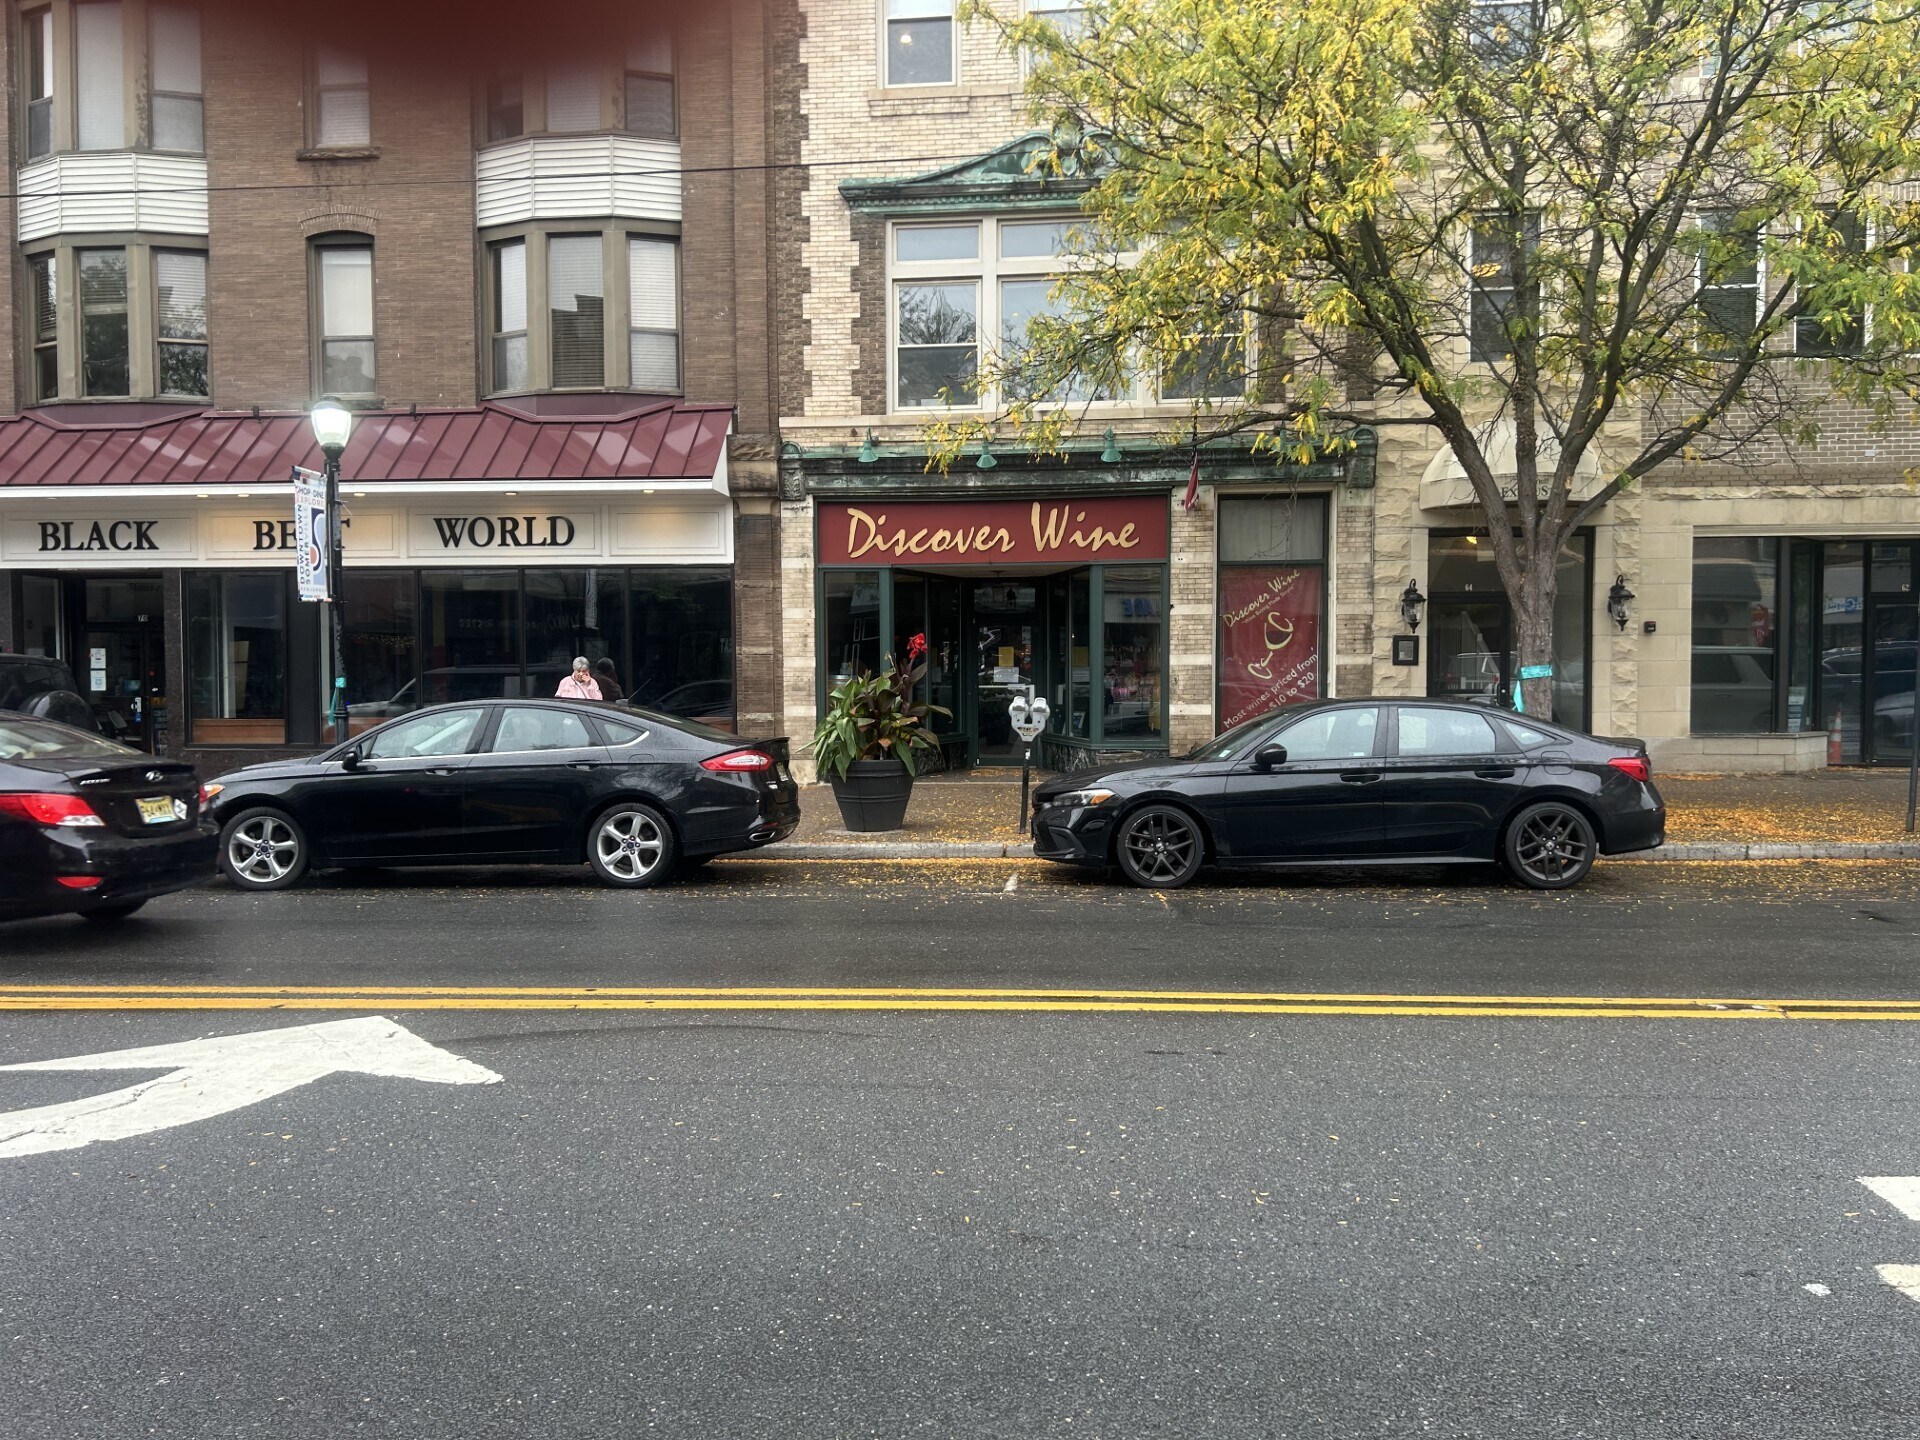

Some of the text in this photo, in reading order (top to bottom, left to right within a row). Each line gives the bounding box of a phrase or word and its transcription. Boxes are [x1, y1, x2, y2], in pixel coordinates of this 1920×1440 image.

[38, 515, 575, 552] BLACK BE WORLD
[297, 504, 305, 584] DOWNTOWN
[847, 501, 1140, 558] Discover Wine
[1223, 569, 1300, 628] Discover Wine
[1901, 583, 1911, 592] 62
[1223, 654, 1318, 728] Most wines priced from
[1269, 671, 1315, 709] $10 to $20
